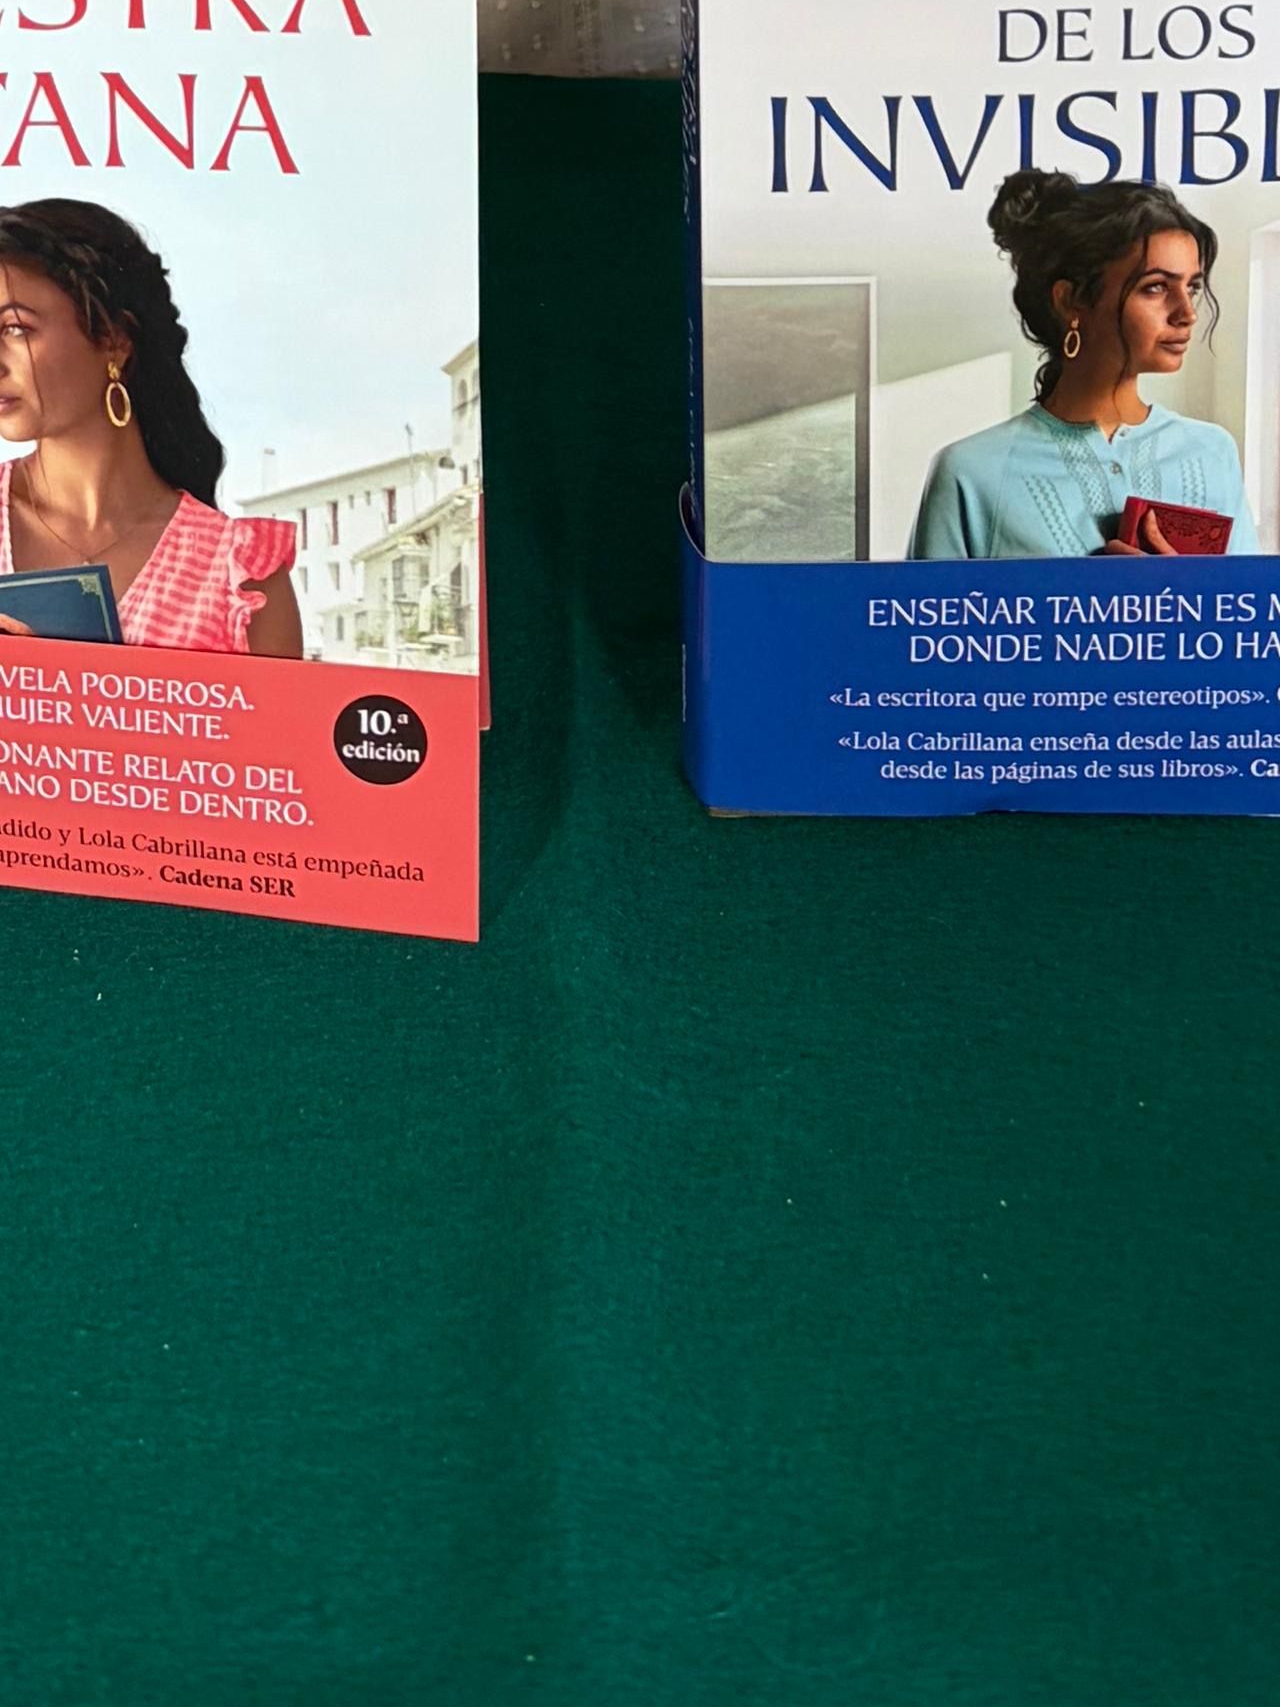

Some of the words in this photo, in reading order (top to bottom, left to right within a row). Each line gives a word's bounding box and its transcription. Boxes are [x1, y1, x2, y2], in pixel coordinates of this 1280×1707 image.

[998, 8, 1093, 63] DE
[1122, 4, 1256, 61] LOS
[868, 591, 1036, 626] ENSEÑAR
[1046, 586, 1202, 624] TAMBIÉN
[1216, 593, 1256, 622] ES
[910, 634, 1042, 663] DONDE
[1055, 632, 1166, 661] NADIE
[1178, 631, 1223, 660] LO
[81, 672, 254, 710] PODEROSA.
[829, 687, 871, 707] «La
[877, 688, 977, 707] escritora
[983, 692, 1026, 712] que
[1032, 691, 1108, 711] rompe
[1113, 686, 1270, 710] estereotipos».
[81, 703, 230, 740] VALIENTE.
[342, 740, 420, 763] edición
[838, 731, 900, 750] «Lola
[907, 732, 1023, 752] Cabrillana
[1029, 732, 1110, 751] enseña
[1116, 731, 1183, 751] desde
[1189, 730, 1220, 750] las
[124, 753, 236, 788] RELATO
[245, 766, 302, 794] DEL
[880, 760, 947, 779] desde
[954, 760, 985, 780] las
[991, 761, 1078, 784] páginas
[1083, 760, 1112, 779] de
[1118, 764, 1155, 778] sus
[1161, 759, 1244, 778] libros».
[70, 778, 170, 812] DESDE
[180, 790, 314, 826] DENTRO.
[58, 828, 71, 847] y
[79, 828, 126, 850] Lola
[131, 833, 247, 864] Cabrillana
[252, 851, 298, 869] está
[304, 857, 425, 882] empeñada
[159, 865, 244, 892] Cadena
[250, 875, 296, 898] SER
